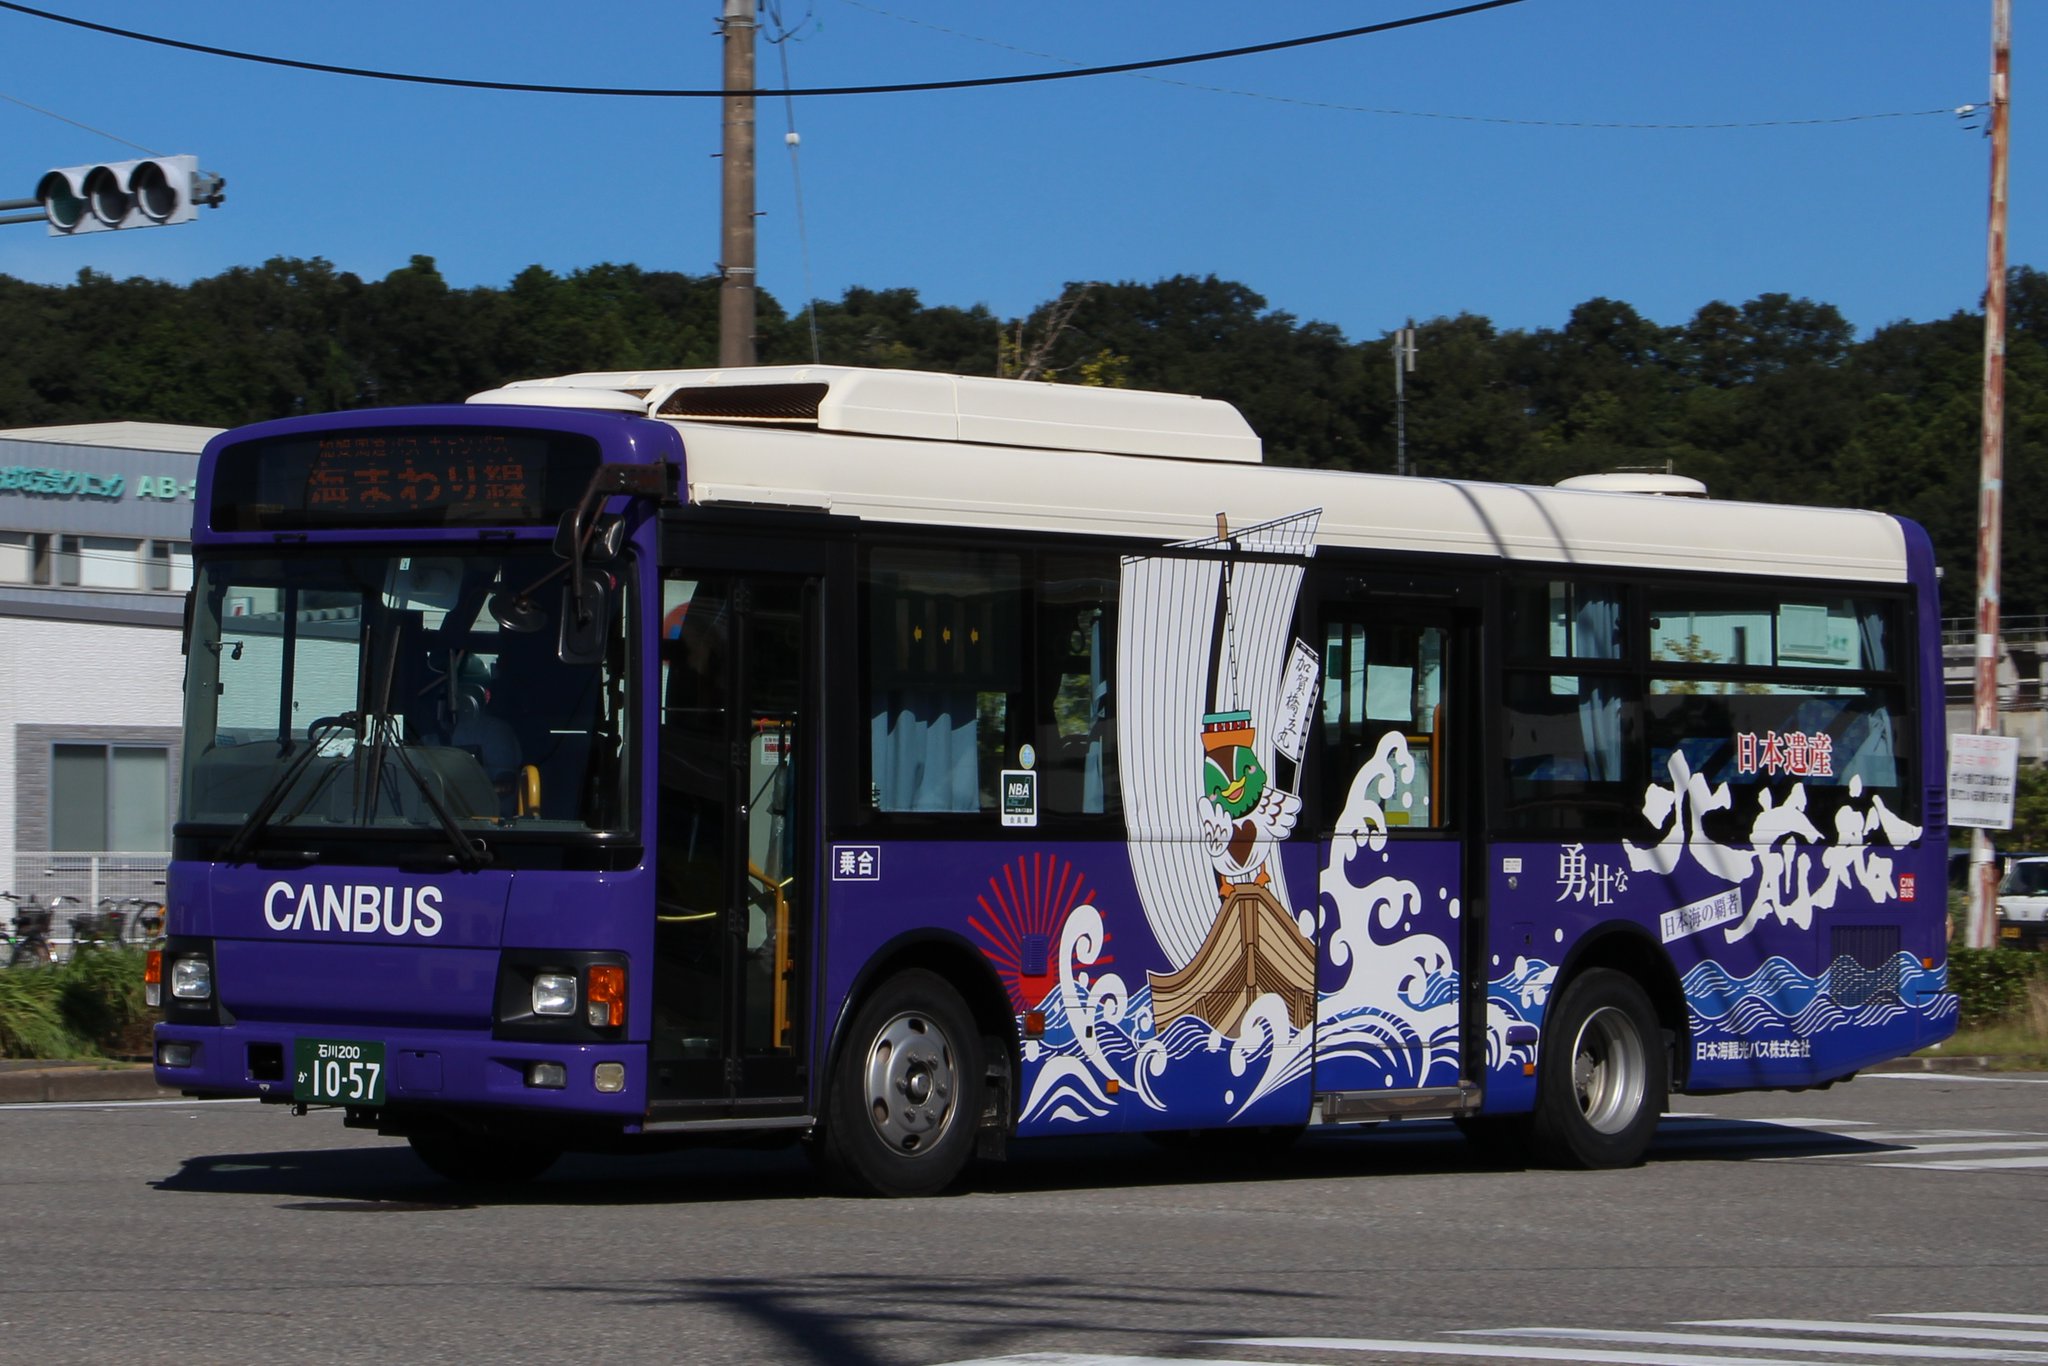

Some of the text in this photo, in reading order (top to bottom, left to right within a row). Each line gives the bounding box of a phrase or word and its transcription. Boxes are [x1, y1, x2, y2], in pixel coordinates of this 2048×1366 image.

[1737, 730, 1833, 777] 日本遺産
[1008, 783, 1029, 796] NBA
[840, 851, 874, 875] 乗合
[1621, 749, 1923, 944] 北前船
[1556, 843, 1629, 907] 勇壮な
[264, 881, 443, 937] CANBUS
[1663, 892, 1741, 939] 日本海の覇者
[1696, 1040, 1811, 1060] 日本海観光バス株式会社
[314, 1060, 380, 1099] 10-57
